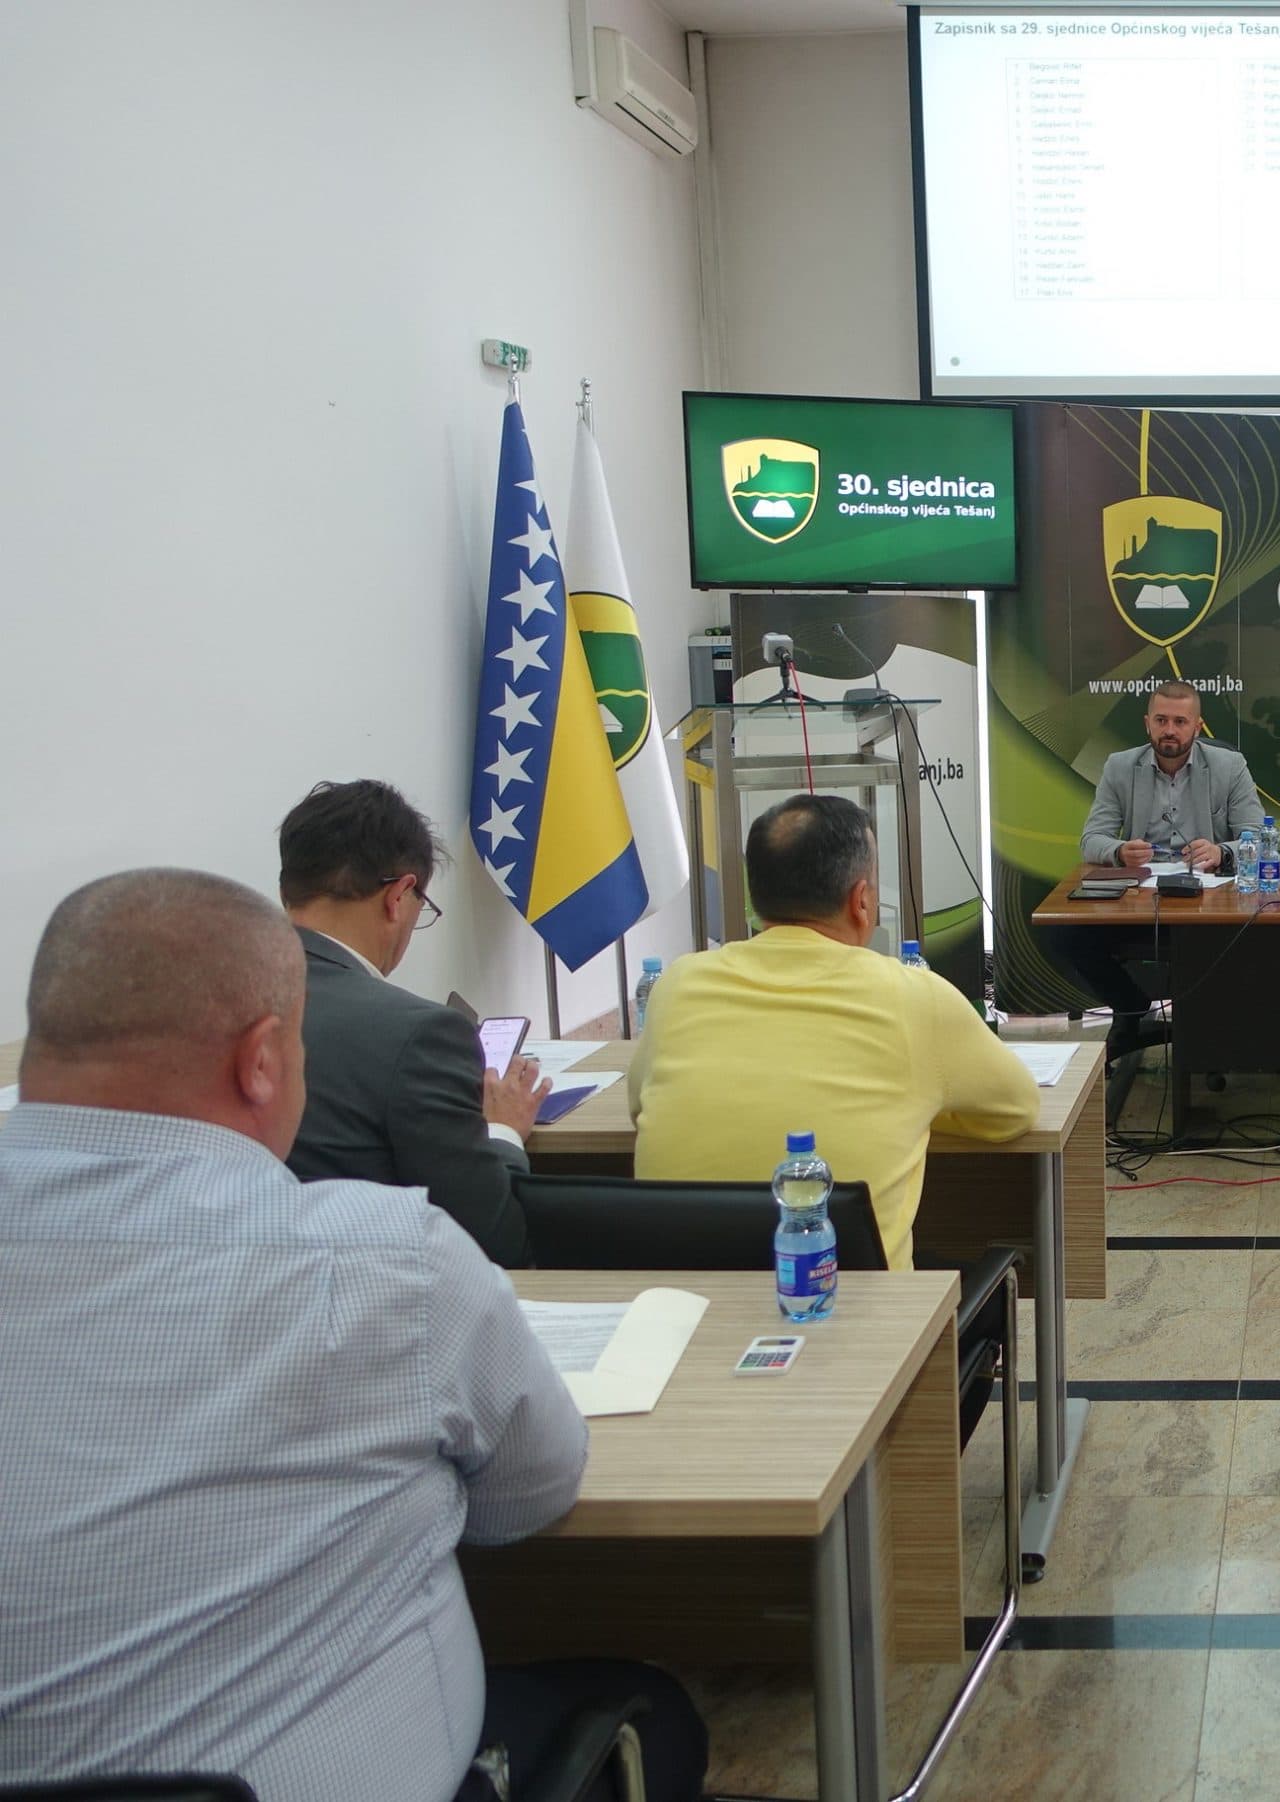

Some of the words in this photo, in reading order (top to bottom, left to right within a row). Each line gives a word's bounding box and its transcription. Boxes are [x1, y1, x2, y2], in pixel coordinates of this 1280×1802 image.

[934, 22, 996, 37] Zapisnik
[1000, 24, 1017, 35] sa
[1021, 22, 1042, 35] 29.
[1046, 22, 1106, 37] sjednice
[1110, 22, 1186, 37] Općinskog
[1191, 23, 1233, 37] vijeća
[837, 473, 879, 496] 30.
[887, 474, 995, 501] sjednica
[838, 502, 908, 517] Općinskog
[911, 503, 950, 517] vijeća
[954, 504, 996, 519] Tešanj
[1088, 675, 1243, 697] www.opcisanj.ba
